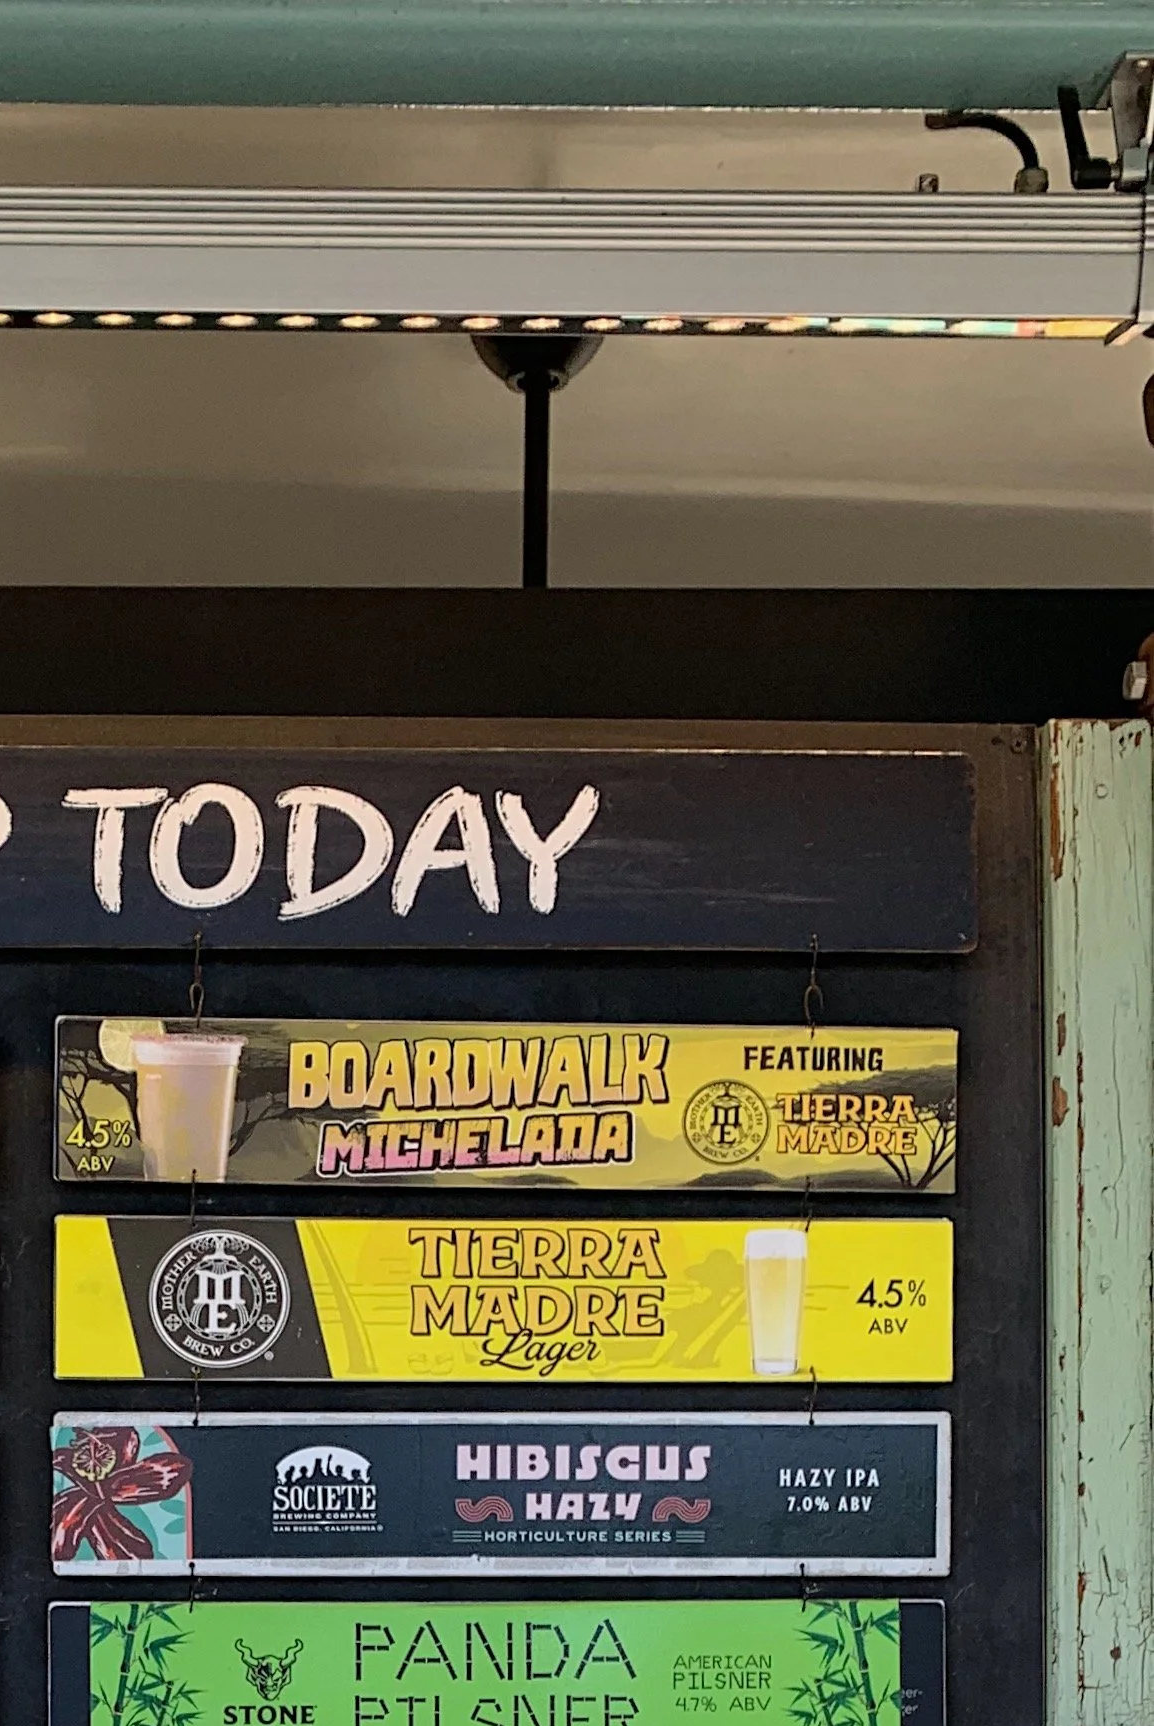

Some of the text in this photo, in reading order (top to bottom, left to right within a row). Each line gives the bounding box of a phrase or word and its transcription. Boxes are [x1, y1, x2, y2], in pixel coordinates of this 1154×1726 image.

[61, 782, 601, 921] TODAY
[287, 1033, 669, 1111] BOARDWALK
[744, 1046, 883, 1072] FEATURING
[776, 1092, 918, 1124] TIERRA
[65, 1118, 132, 1149] 4.5%
[318, 1112, 633, 1178] MICHELADA
[776, 1124, 917, 1156] MADRE
[76, 1155, 115, 1172] ABV
[409, 1228, 667, 1278] TIERRA
[161, 1250, 278, 1310] MOTHER EARTH
[856, 1277, 926, 1308] 4.5%
[410, 1284, 665, 1336] MADRE
[868, 1318, 908, 1335] ABV
[182, 1335, 225, 1358] BREW
[479, 1329, 601, 1377] Lager
[456, 1445, 711, 1481] HIBISCUS
[779, 1468, 880, 1487] HAZY IPA
[272, 1485, 377, 1511] SOCIETE
[526, 1493, 642, 1521] HAZY
[787, 1496, 872, 1512] 7.0% ABV
[326, 1512, 377, 1520] COMPANY
[484, 1530, 672, 1543] HORTICULTURE SERIES
[355, 1618, 637, 1680] PANDA
[673, 1655, 771, 1669] AMERICAN
[673, 1672, 771, 1690] PILSNER
[223, 1705, 316, 1725] STONE
[675, 1696, 771, 1712] 4.7% ABV
